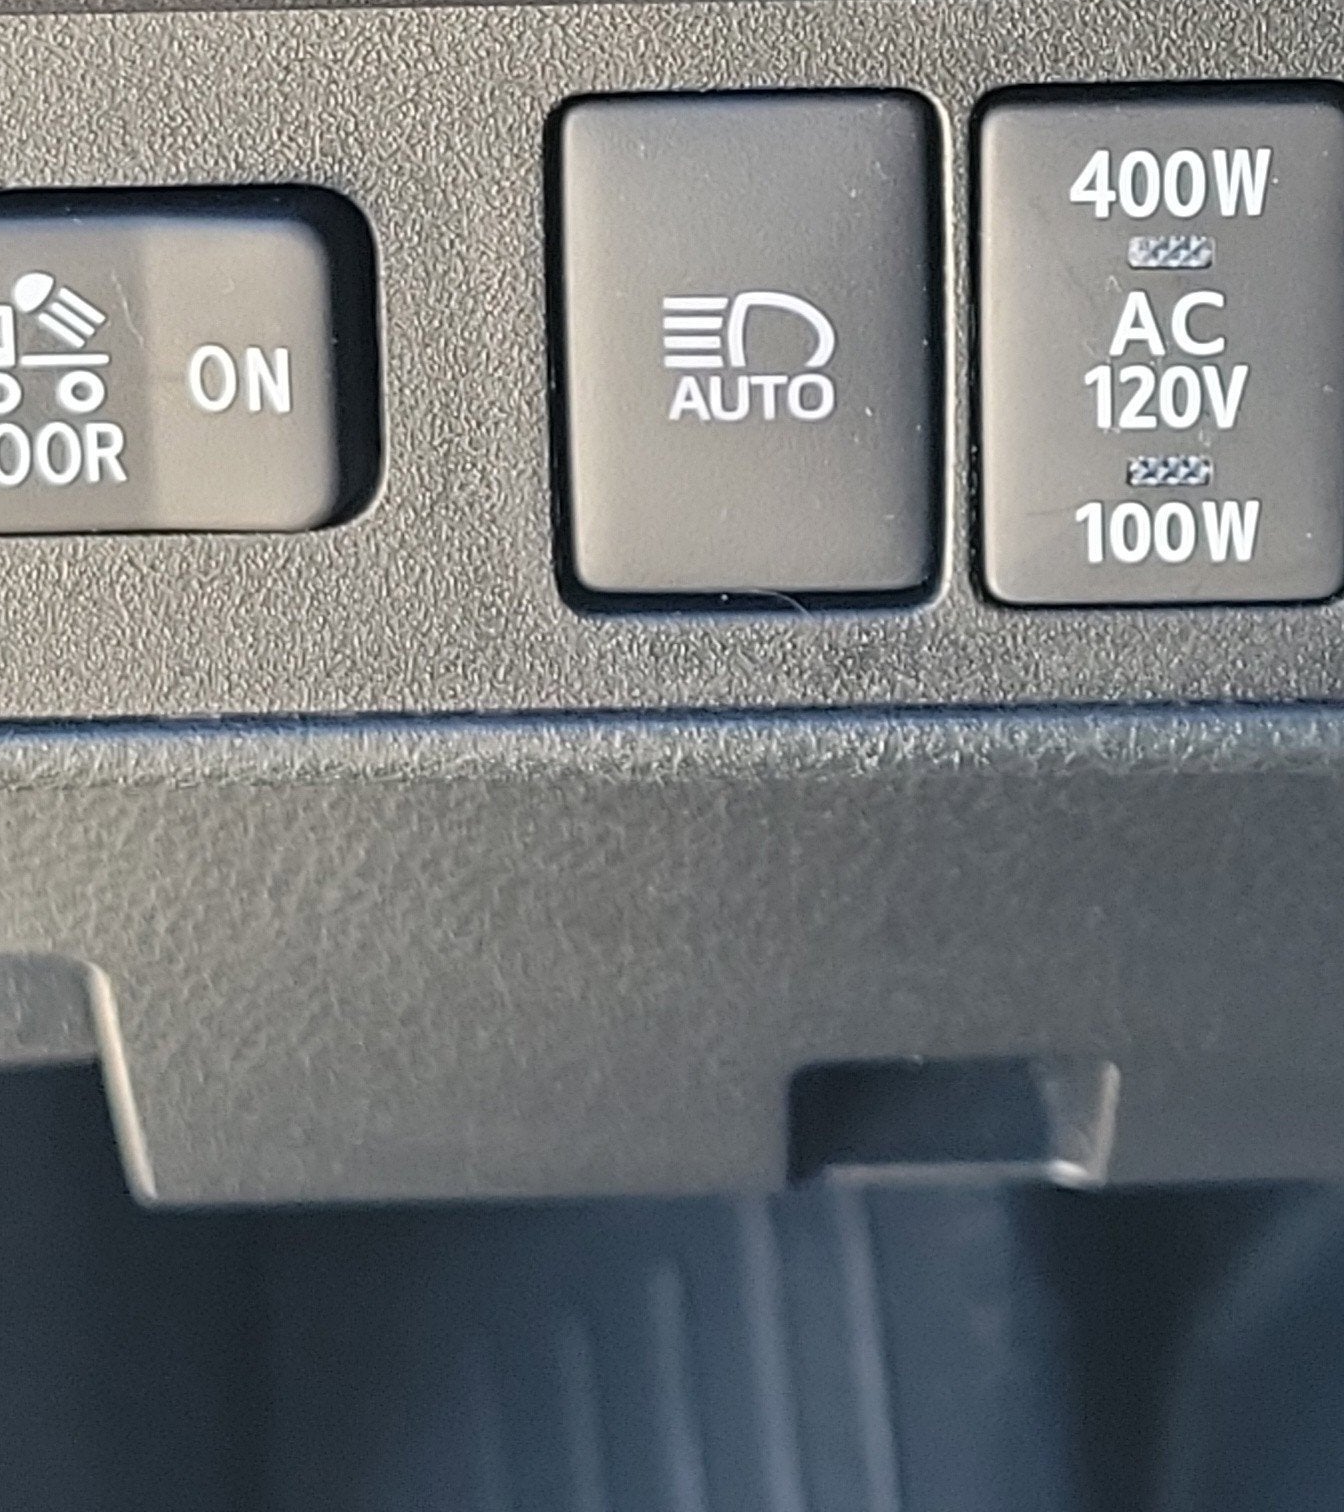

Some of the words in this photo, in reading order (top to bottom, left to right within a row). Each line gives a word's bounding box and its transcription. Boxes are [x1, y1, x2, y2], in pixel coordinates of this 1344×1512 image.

[1069, 148, 1272, 219] 400W
[1109, 290, 1227, 356] AC
[189, 345, 292, 414] ON
[668, 373, 836, 421] AUTO
[1084, 365, 1249, 429] 120V
[1075, 500, 1260, 563] 100W
